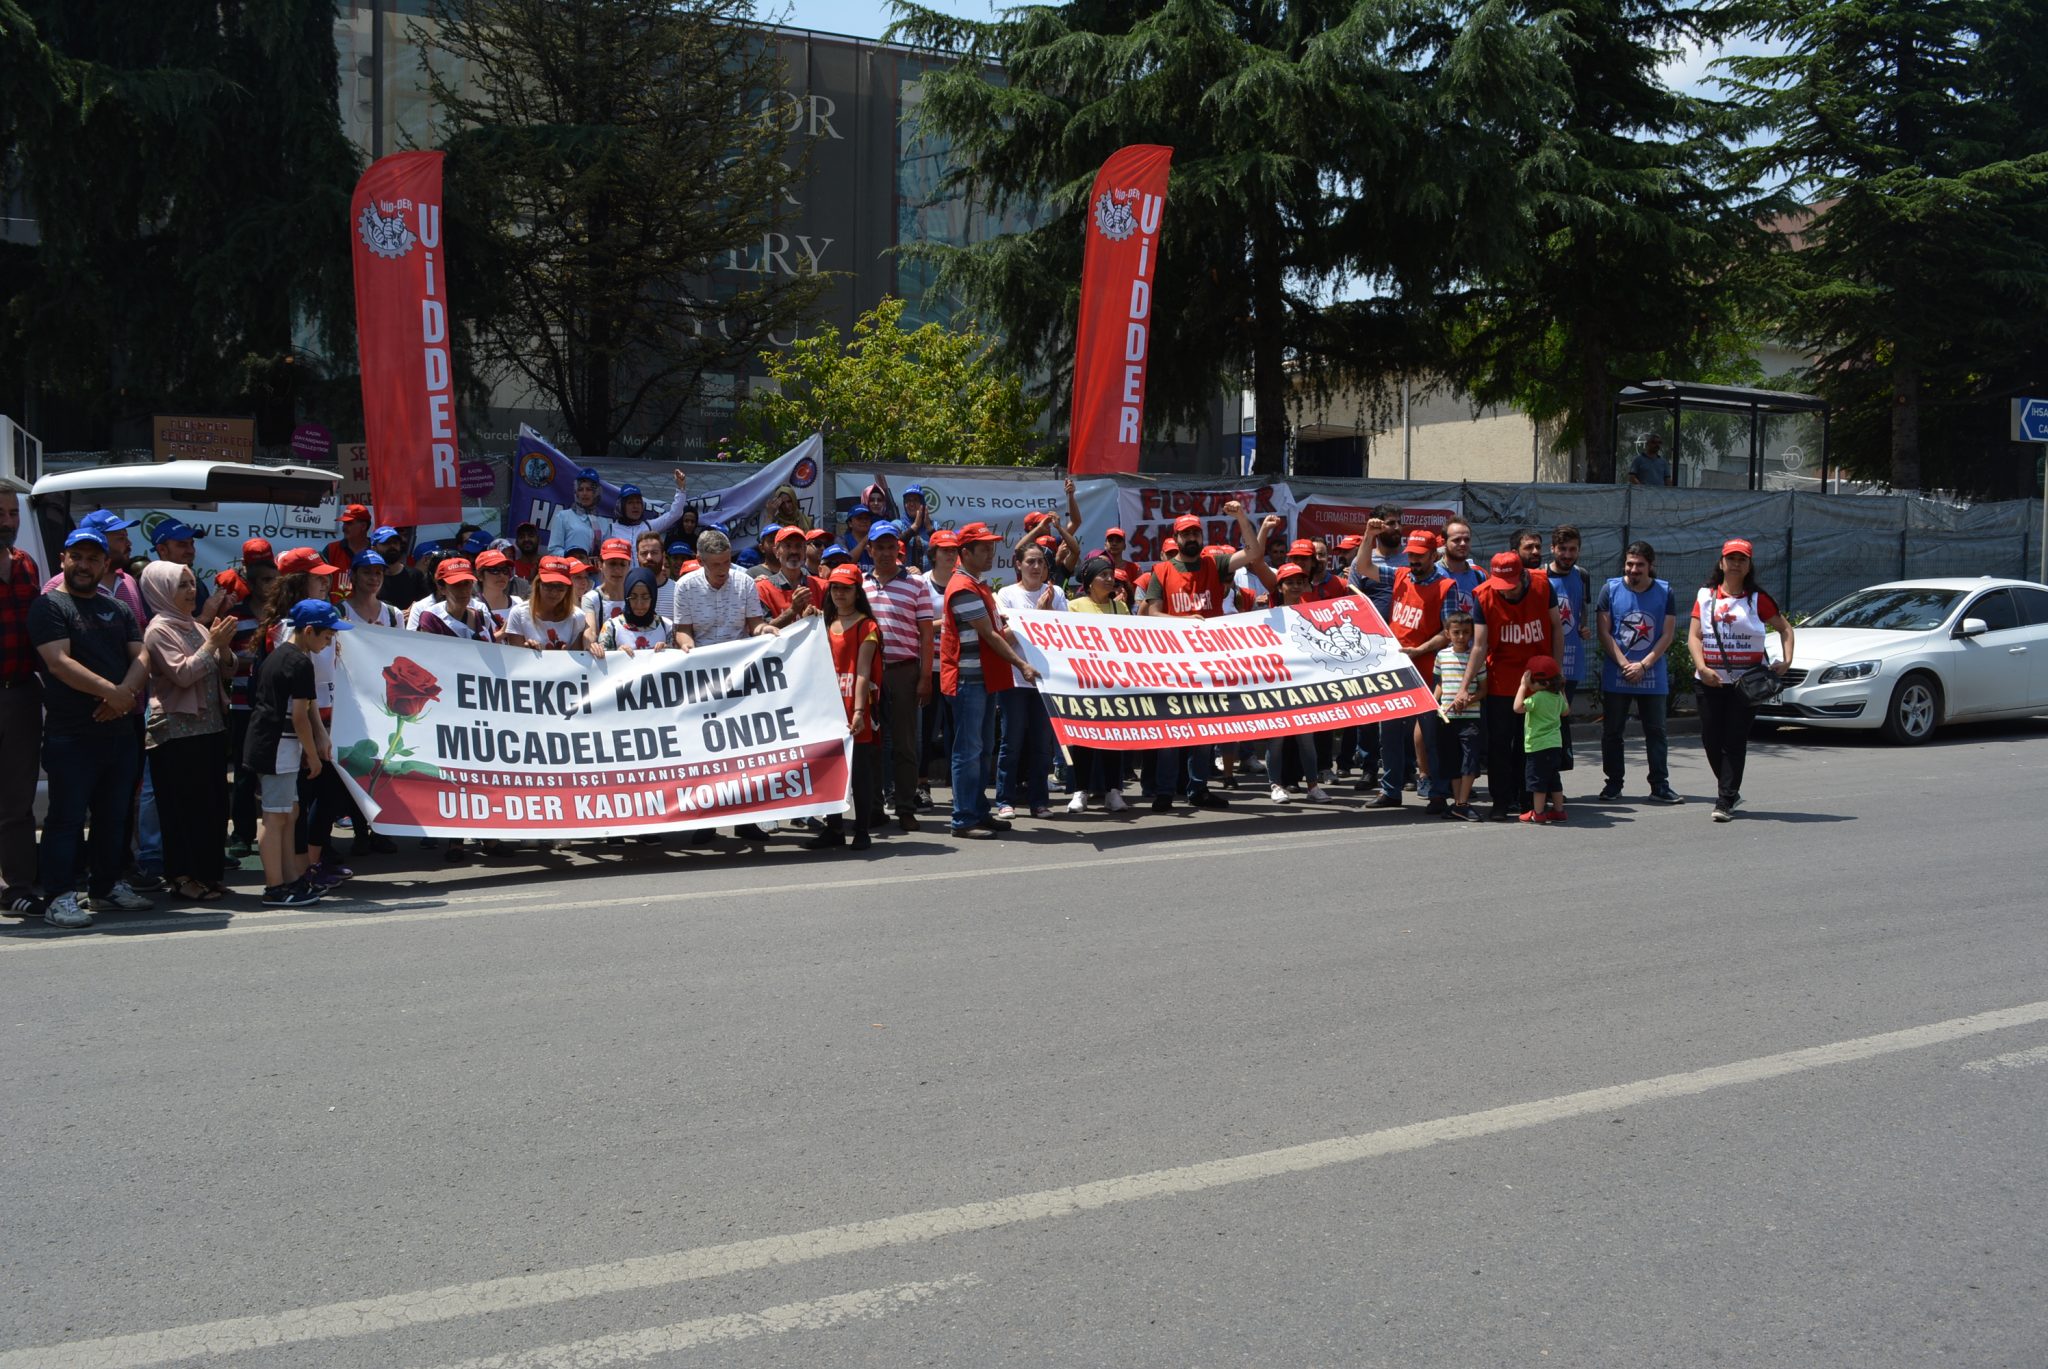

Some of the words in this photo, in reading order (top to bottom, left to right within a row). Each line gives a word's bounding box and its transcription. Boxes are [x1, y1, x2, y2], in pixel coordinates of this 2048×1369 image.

[946, 496, 986, 507] YVES
[991, 498, 1058, 508] ROCHER
[1310, 599, 1359, 623] UİD-DER
[1020, 616, 1108, 652] İŞÇİLER
[1113, 626, 1185, 655] BOYUN
[1186, 620, 1283, 652] EĞMİYOR
[1500, 619, 1545, 644] UİD-DER
[456, 673, 593, 720] EMEKÇİ
[615, 656, 788, 711] KADINLAR
[1068, 655, 1201, 690] MÜCADELE
[1202, 653, 1293, 689] EDİYOR
[1053, 694, 1157, 720] YAŞASIN
[1168, 693, 1230, 715] SINIF
[1245, 673, 1404, 712] DAYANIŞMASI
[437, 719, 682, 765] MÜCADELEDE
[702, 706, 800, 753] ÖNDE
[1064, 724, 1163, 743] ULUSLARARASI
[1166, 720, 1196, 740] İŞÇİ
[1199, 715, 1289, 737] DAYANIŞMASI
[1293, 706, 1350, 727] DERNEĞİ
[438, 768, 564, 787] ULUSLARARASI
[572, 769, 606, 788] İŞÇİ
[616, 761, 729, 785] DAYANIŞMASI
[737, 747, 806, 769] DERNEĞİ
[438, 787, 564, 821] UİD-DER
[576, 789, 666, 819] KADIN
[679, 763, 812, 812] KOMİTESİ
